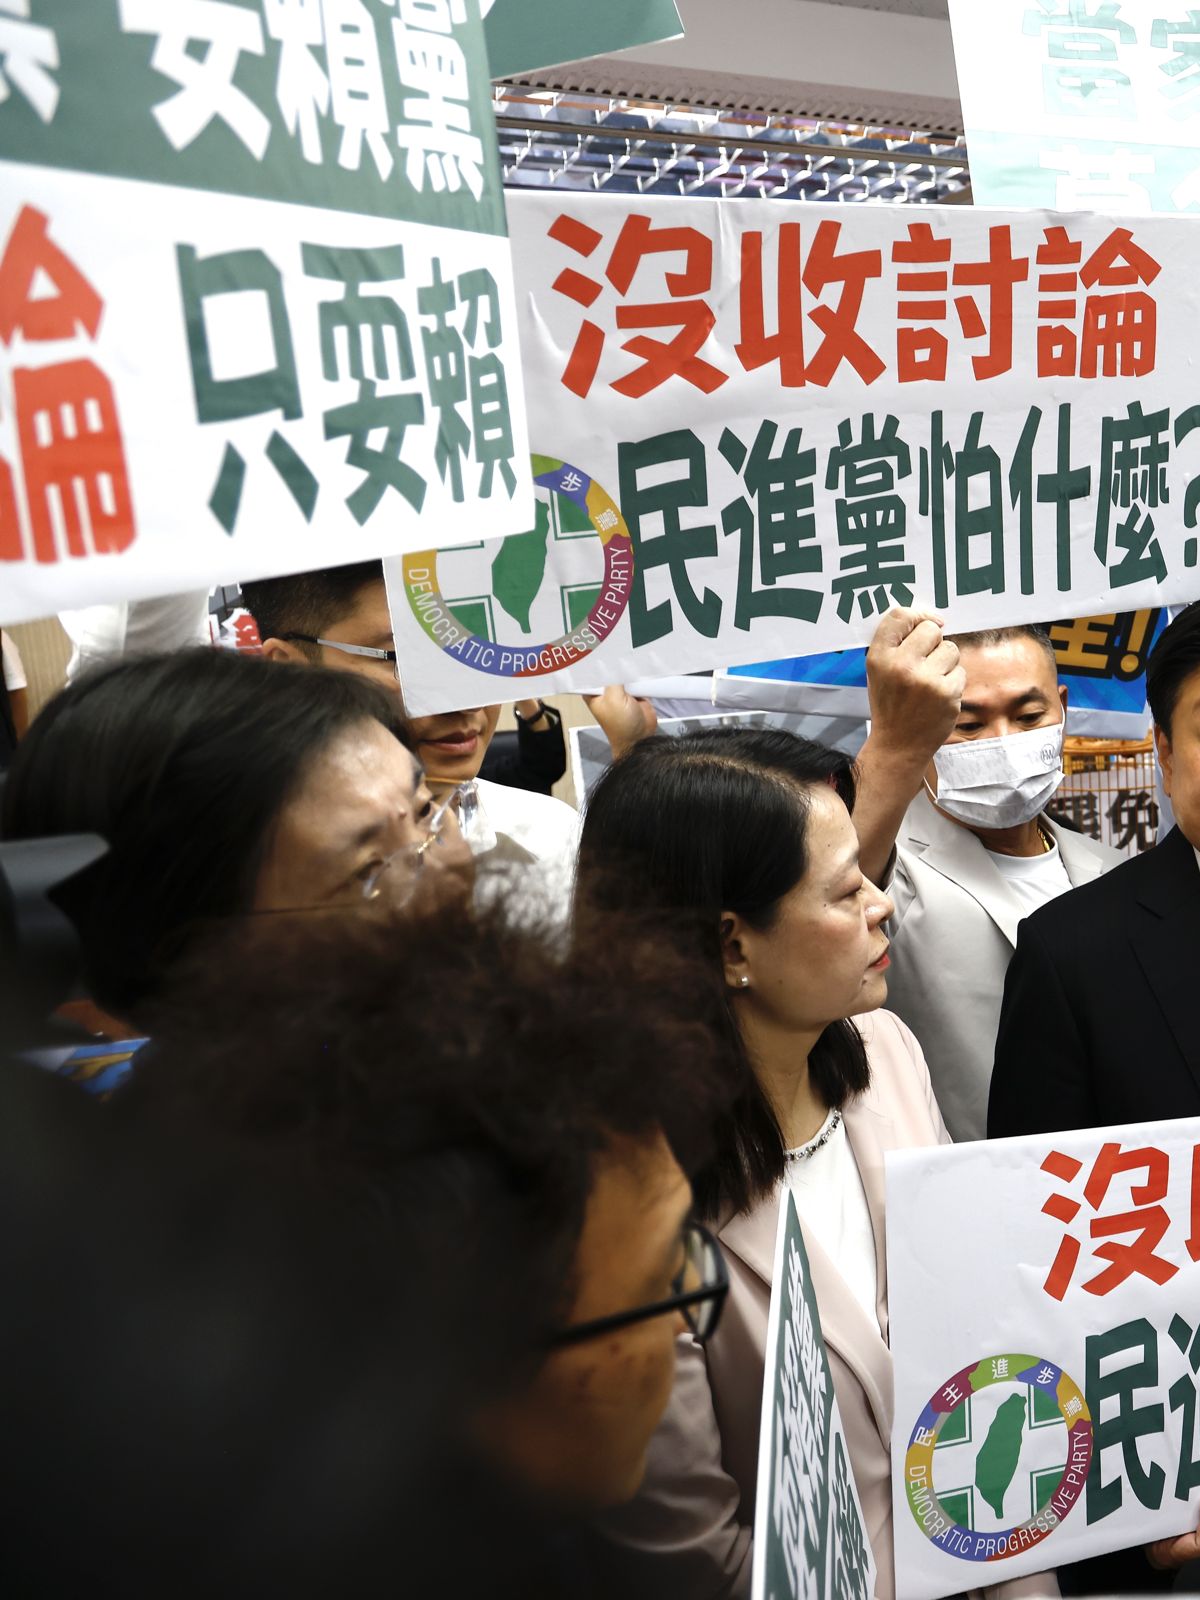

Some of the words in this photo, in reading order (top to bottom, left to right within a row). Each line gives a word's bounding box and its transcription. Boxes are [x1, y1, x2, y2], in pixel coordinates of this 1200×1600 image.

[547, 213, 1162, 399] 沒收討論
[174, 241, 518, 538] 只耍賴
[408, 567, 496, 668] DEMOCRATIC
[499, 604, 617, 673] PROGRESSIVE
[604, 547, 628, 605] PARTY
[913, 1357, 1084, 1448] 民主進步黨
[908, 1465, 973, 1555] DEMOCRATIC
[974, 1486, 1076, 1557] PROGRESSIVE
[1065, 1430, 1089, 1486] PARTY
